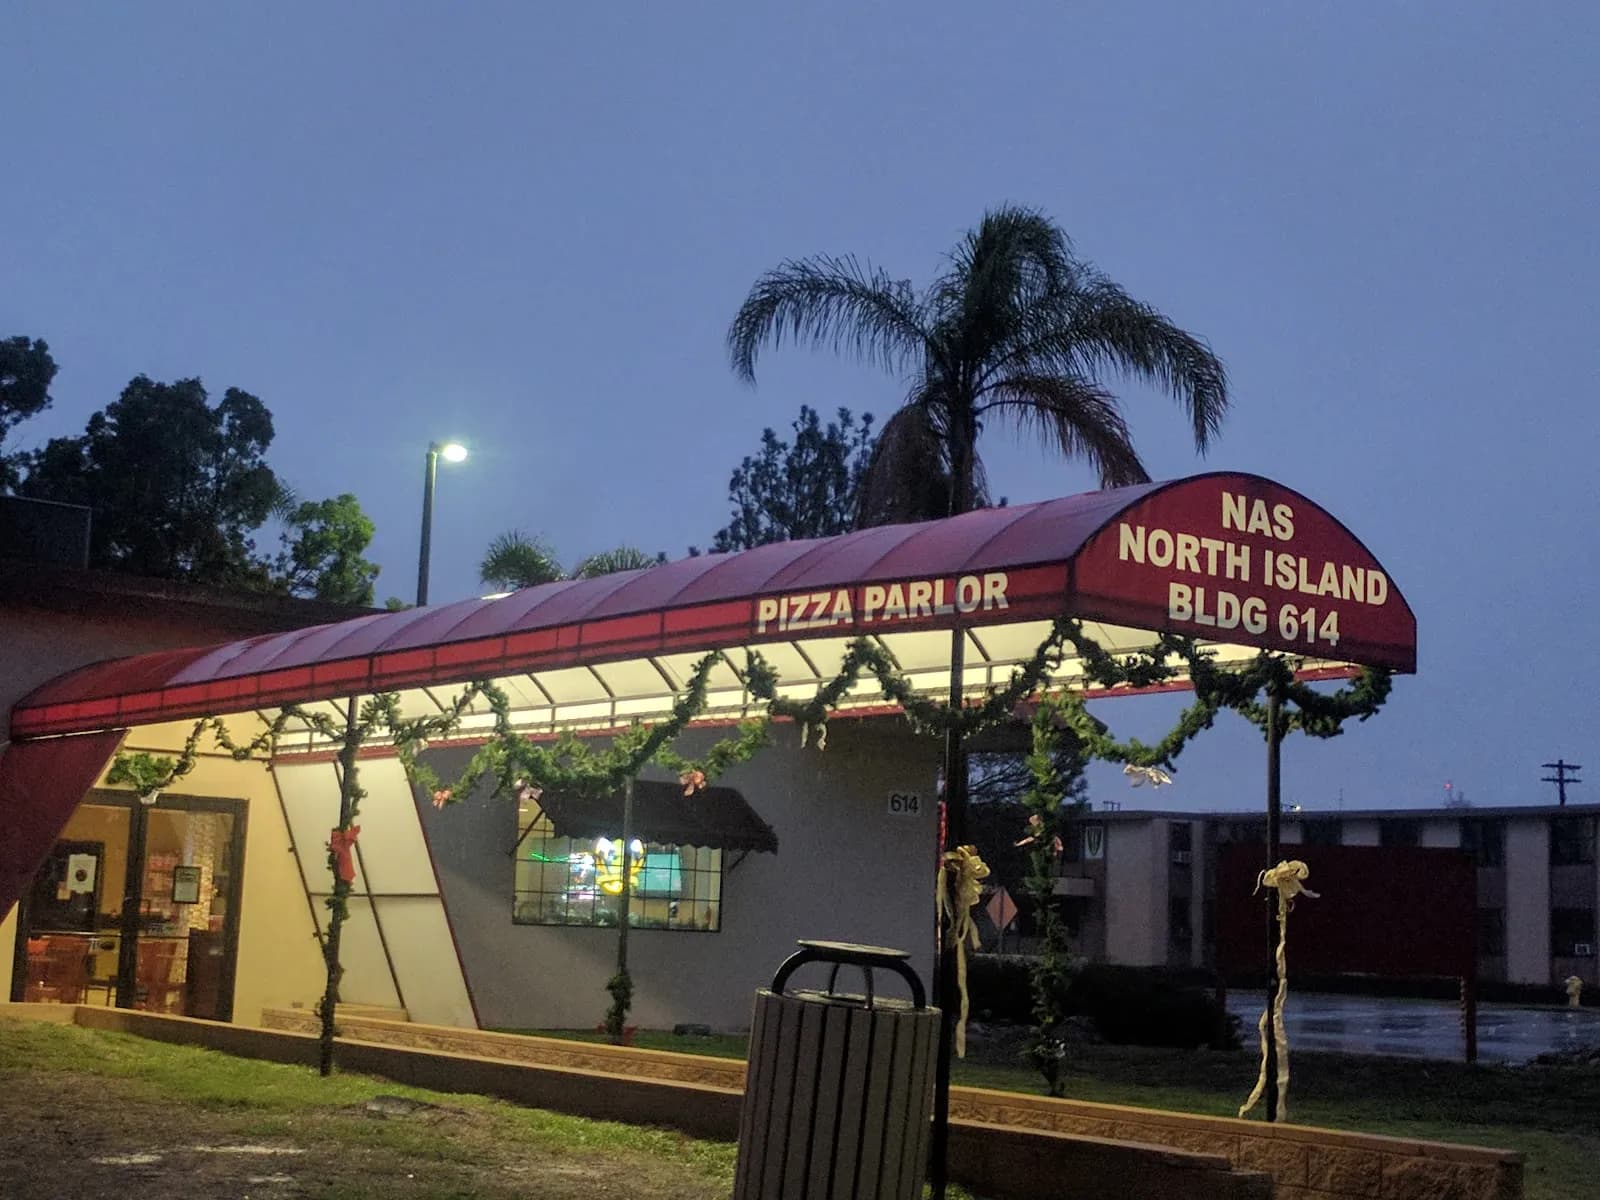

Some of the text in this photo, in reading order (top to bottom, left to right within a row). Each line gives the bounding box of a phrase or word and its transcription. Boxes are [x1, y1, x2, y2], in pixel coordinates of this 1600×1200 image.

[1222, 492, 1294, 541] NAS
[1119, 523, 1388, 605] NORTH ISLAND
[758, 572, 1009, 633] PIZZA PARLOR
[1169, 582, 1340, 646] BLDG 614
[890, 793, 919, 813] 614
